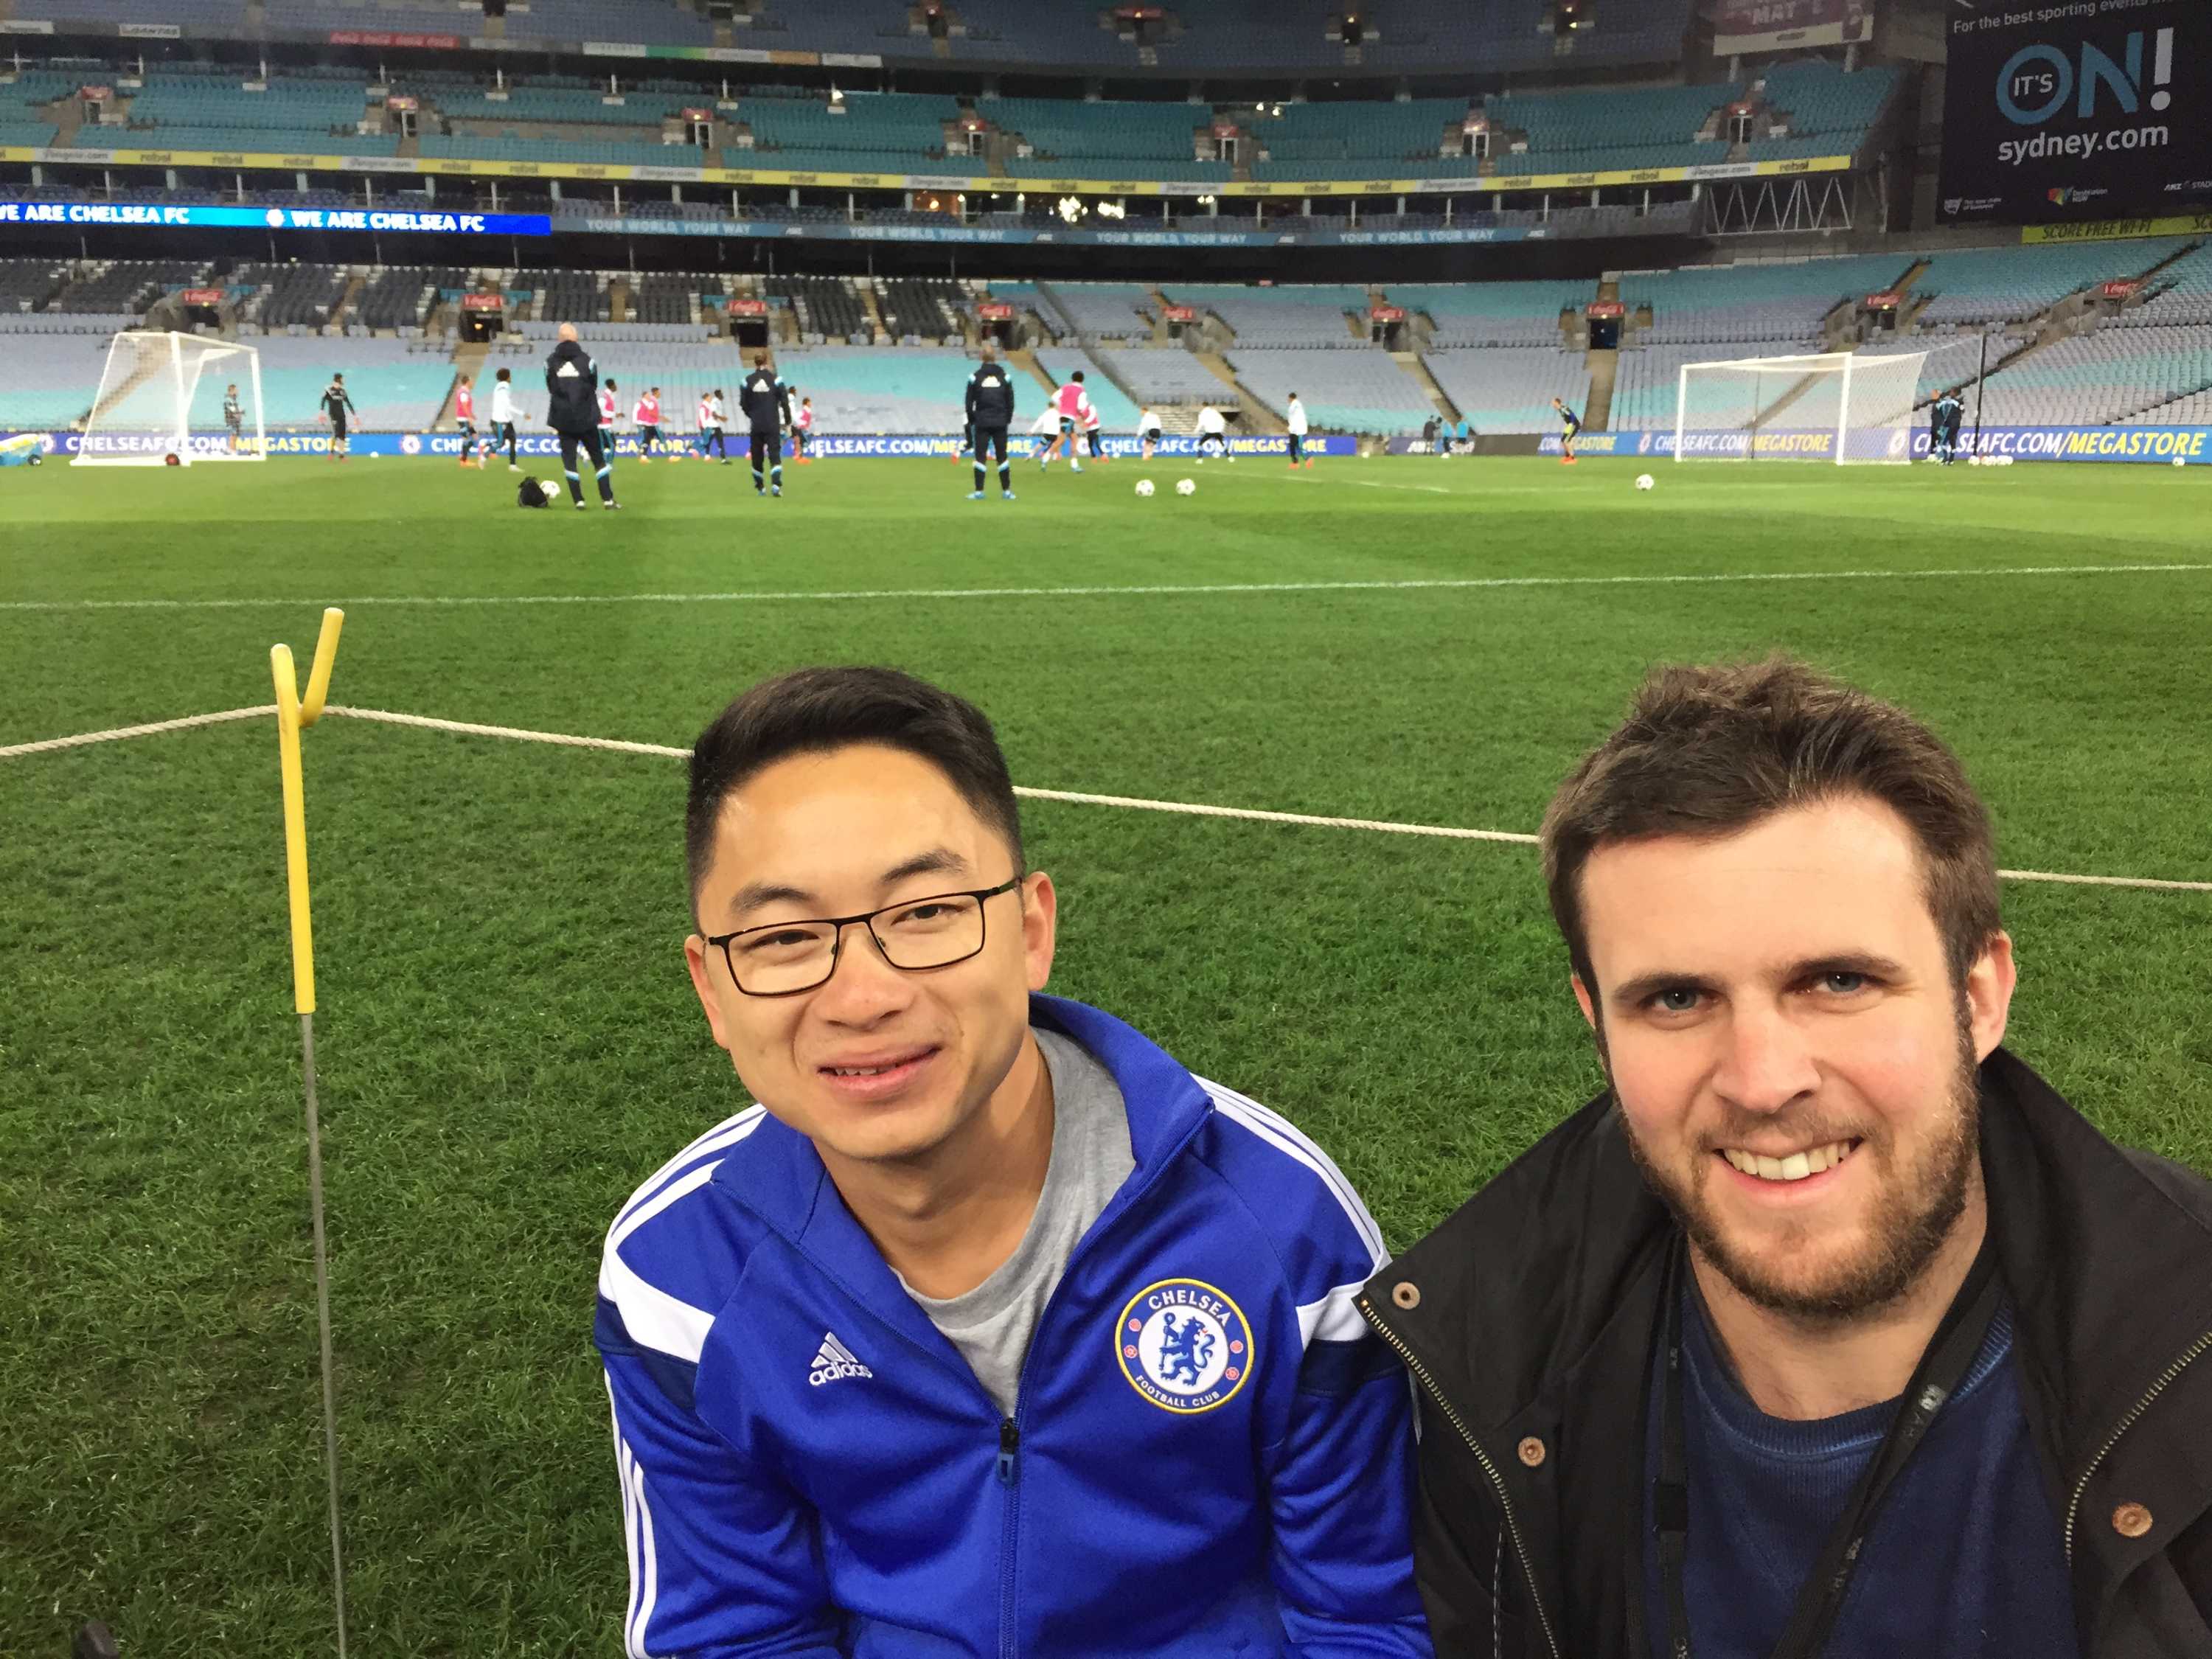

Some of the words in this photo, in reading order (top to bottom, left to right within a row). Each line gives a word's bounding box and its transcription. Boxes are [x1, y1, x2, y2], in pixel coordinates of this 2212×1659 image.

[1954, 21, 1975, 33] For
[1979, 16, 2000, 29] the
[2004, 10, 2034, 25] best
[2037, 2, 2096, 22] sporting
[2014, 74, 2053, 97] IT'S
[1997, 126, 2169, 165] sydney.com
[25, 205, 65, 222] ARE
[69, 206, 161, 223] CHELSEA
[164, 208, 190, 224] FC
[291, 210, 323, 228] WE
[327, 212, 368, 229] ARE
[369, 212, 458, 232] CHELSEA
[460, 215, 486, 232] FC
[2042, 223, 2083, 240] SCORE
[2085, 221, 2115, 237] FREE
[1148, 1290, 1231, 1327] CHELSEA
[809, 1360, 873, 1386] adidas
[1135, 1374, 1186, 1408] FOOTBALL
[1192, 1390, 1220, 1407] CLUB
